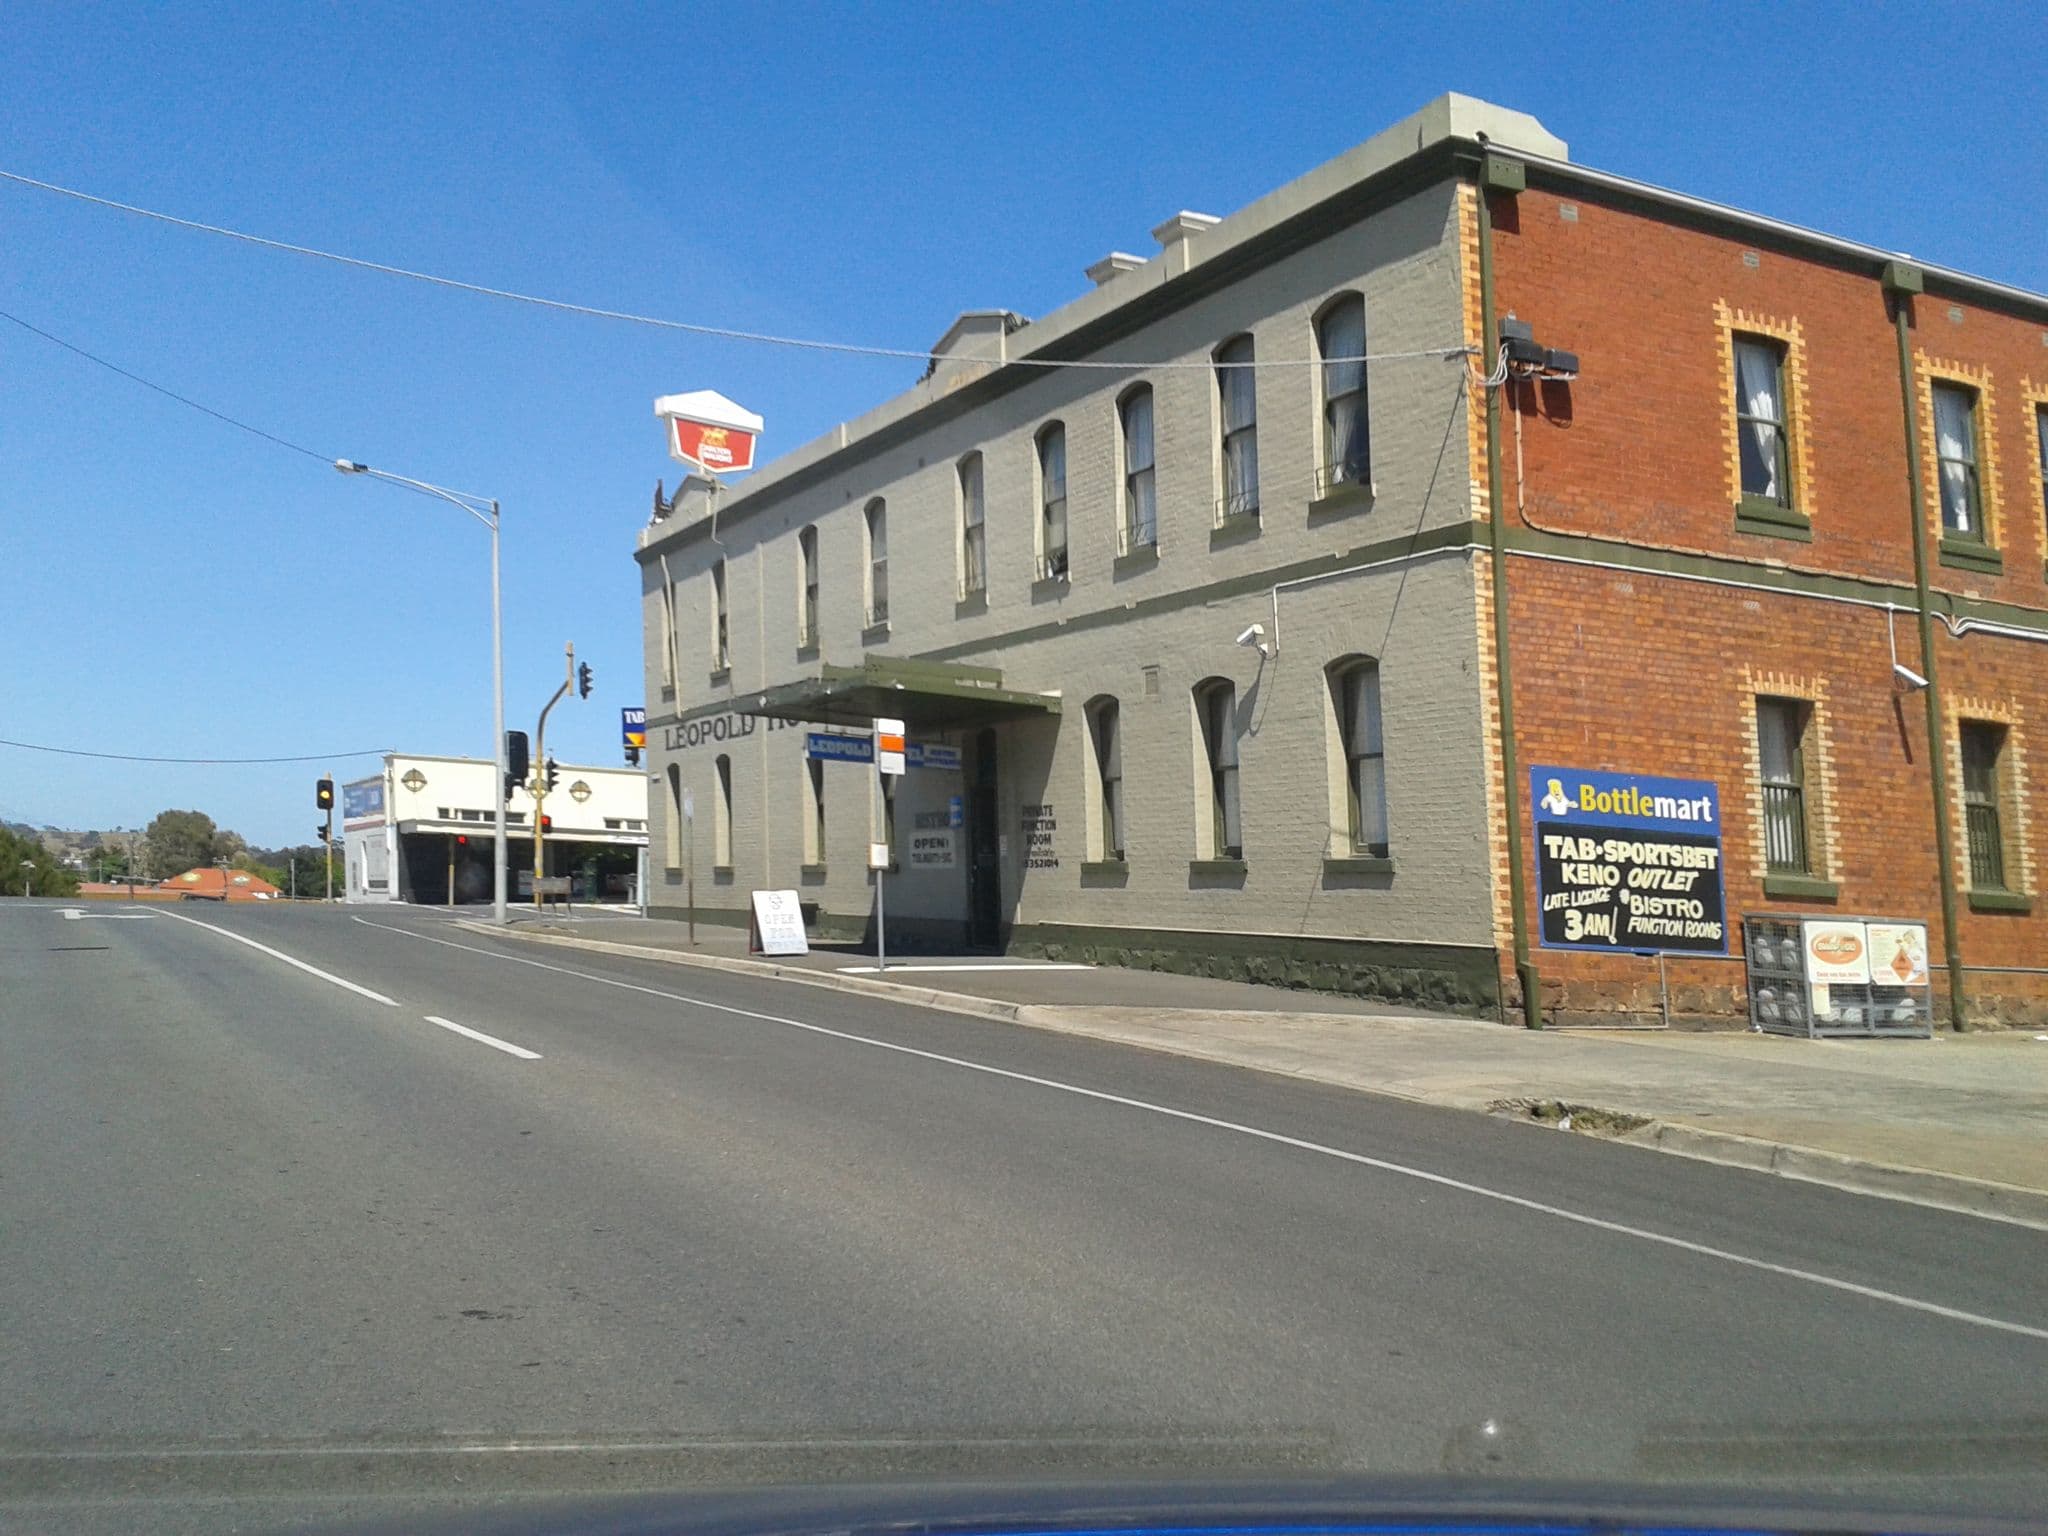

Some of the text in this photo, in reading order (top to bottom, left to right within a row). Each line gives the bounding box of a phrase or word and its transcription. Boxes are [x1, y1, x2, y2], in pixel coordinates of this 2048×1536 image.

[624, 710, 645, 724] TAB
[664, 713, 756, 751] LEOPOLD
[809, 737, 872, 757] LEOPOLD
[1579, 784, 1713, 822] Bottlemart
[1026, 833, 1052, 846] ROOM
[1561, 863, 1700, 892] KENO OUTLET
[1543, 892, 1570, 912] LATE
[1630, 894, 1704, 919] BISTRO
[1627, 916, 1722, 940] FUNCTION ROOMS
